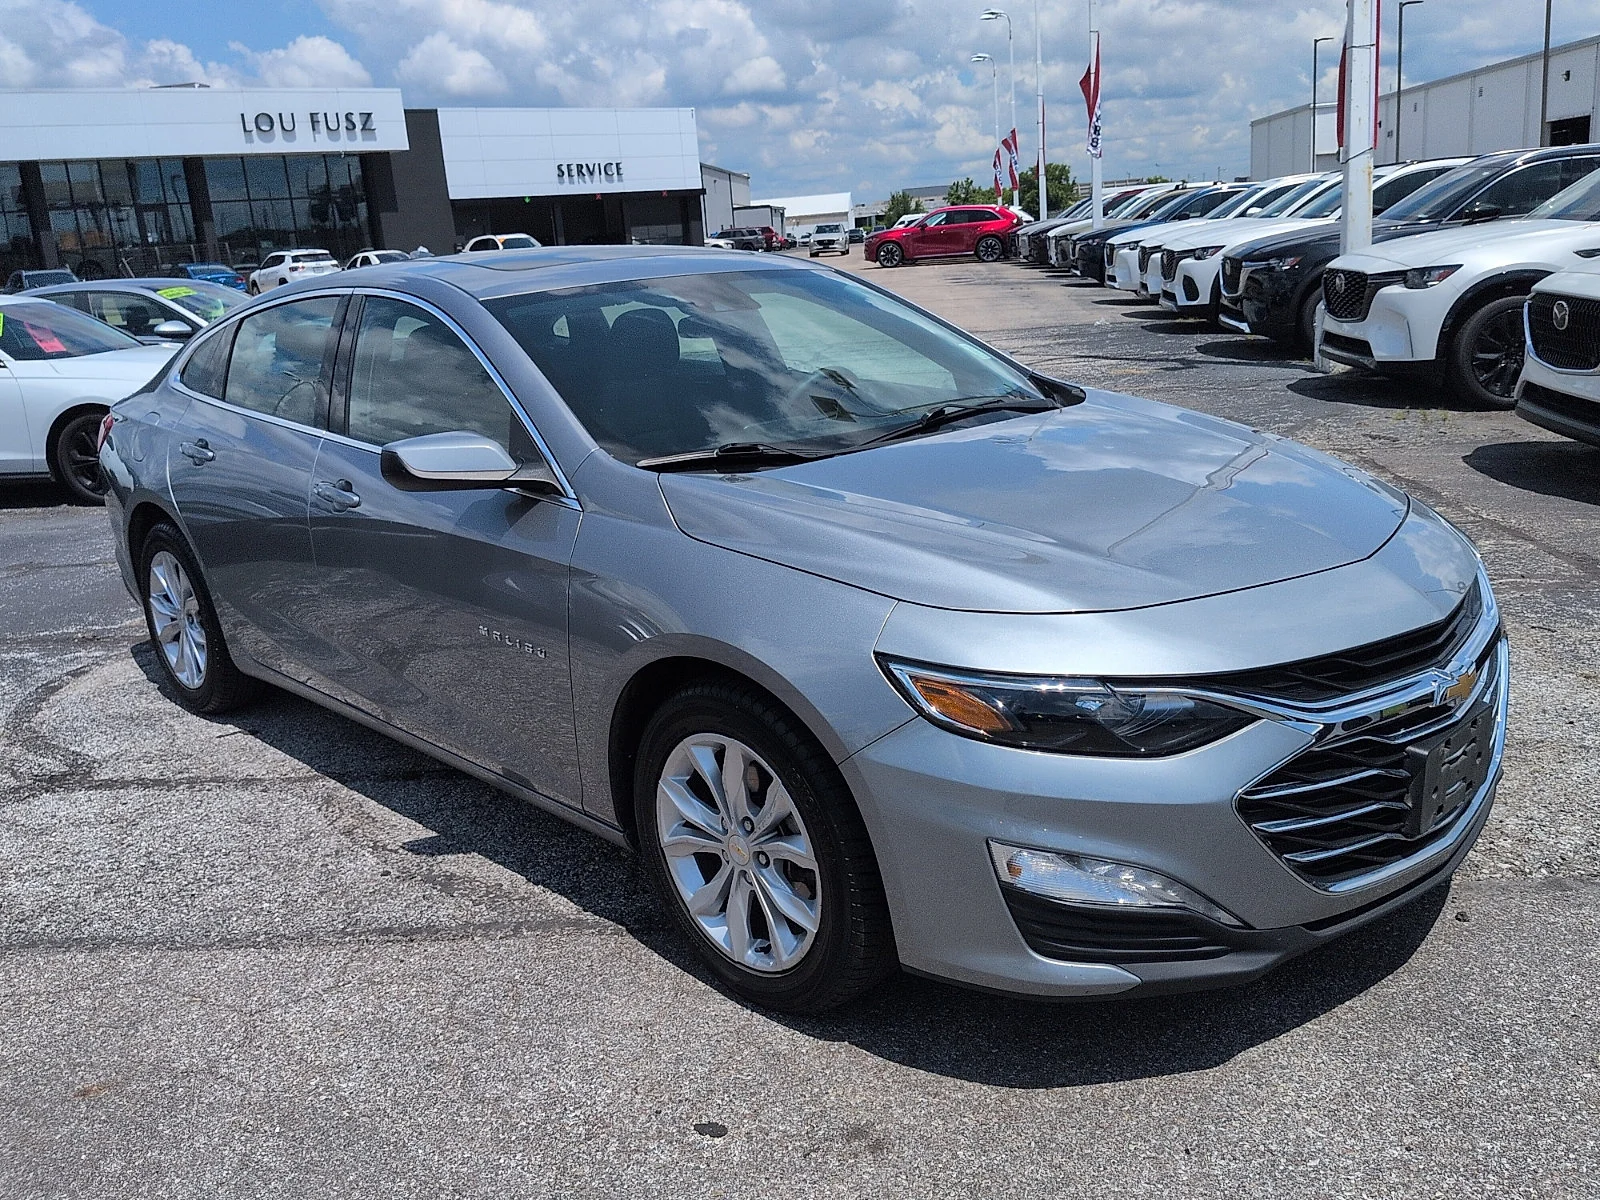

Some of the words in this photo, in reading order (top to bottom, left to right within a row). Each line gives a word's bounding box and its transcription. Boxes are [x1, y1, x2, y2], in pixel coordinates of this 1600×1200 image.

[240, 112, 296, 133] LOU
[309, 111, 377, 132] FUSZ
[556, 162, 624, 178] SERVICE
[479, 625, 546, 659] MALIBU
